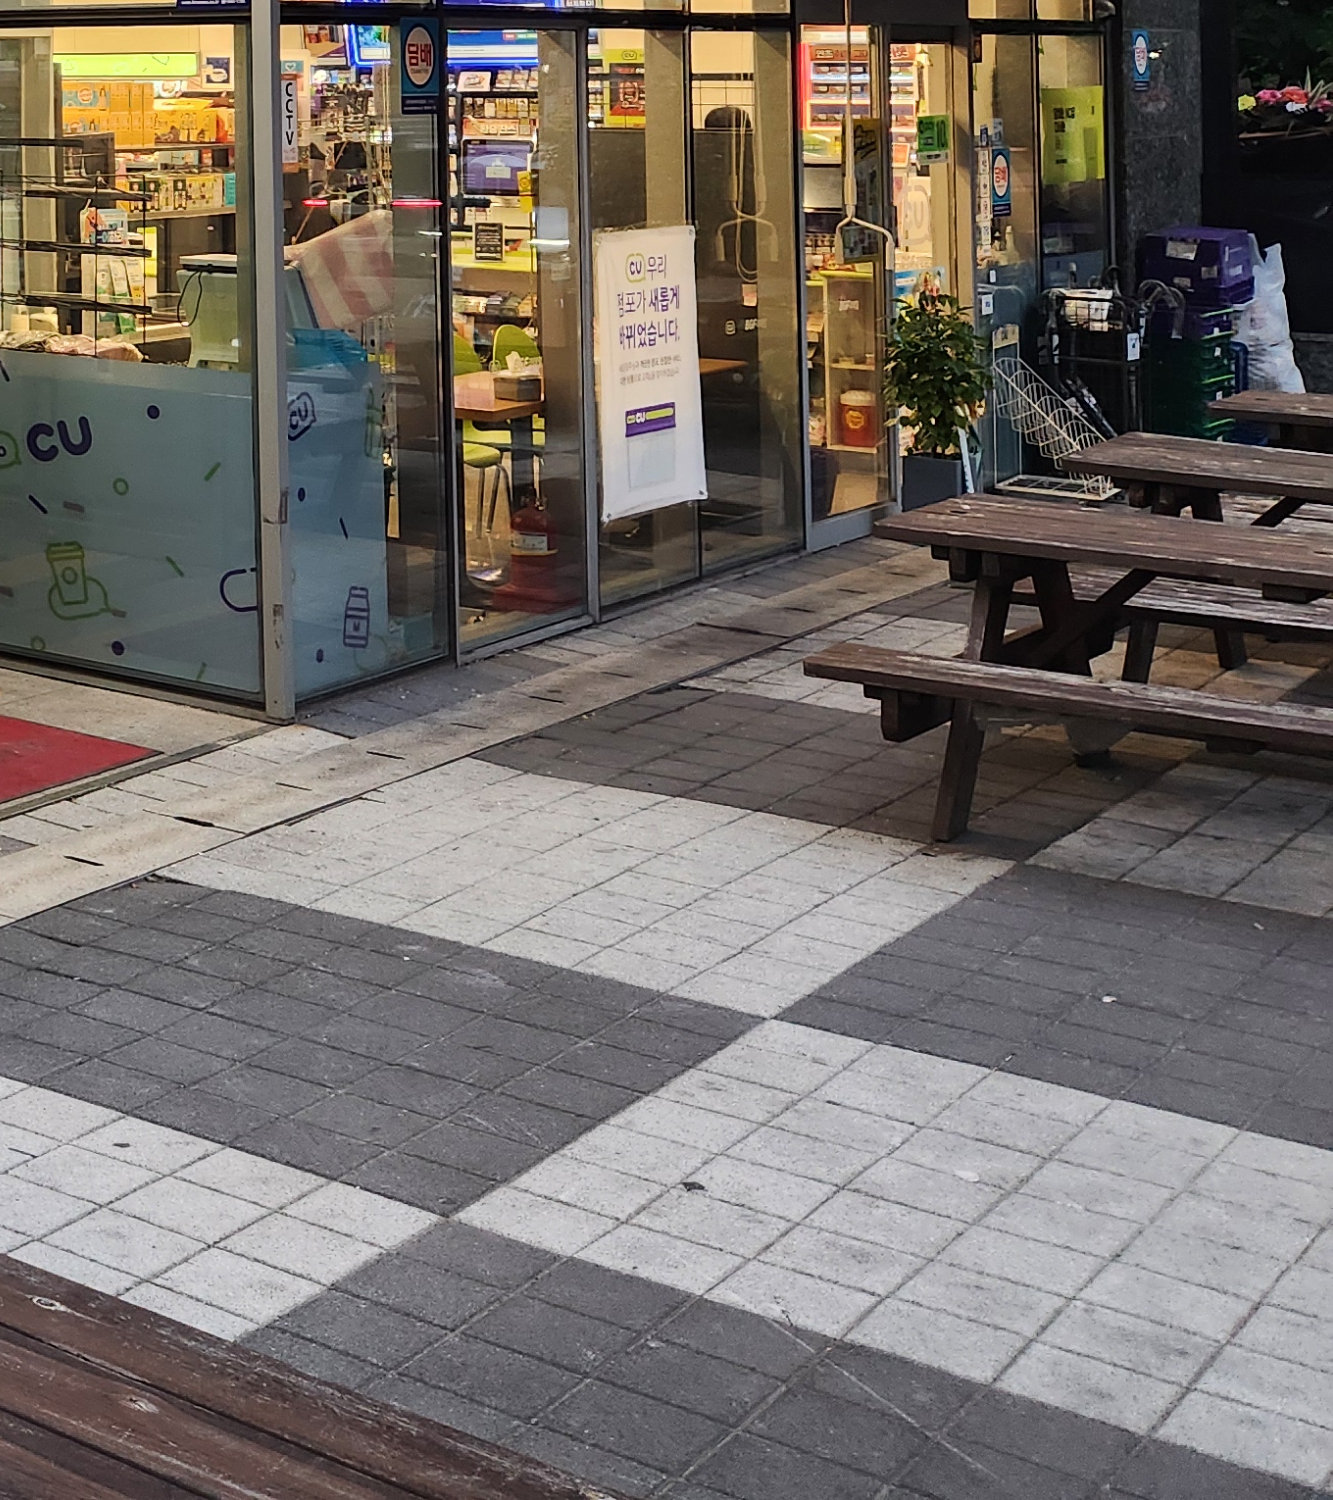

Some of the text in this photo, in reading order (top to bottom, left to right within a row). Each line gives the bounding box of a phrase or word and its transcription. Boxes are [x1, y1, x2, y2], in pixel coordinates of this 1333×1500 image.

[407, 40, 432, 68] 담배
[284, 82, 295, 146] CCTV
[628, 254, 668, 281] CU 우리
[617, 284, 681, 318] 점포가 새롭게
[289, 400, 310, 428] CU
[26, 415, 93, 463] CU
